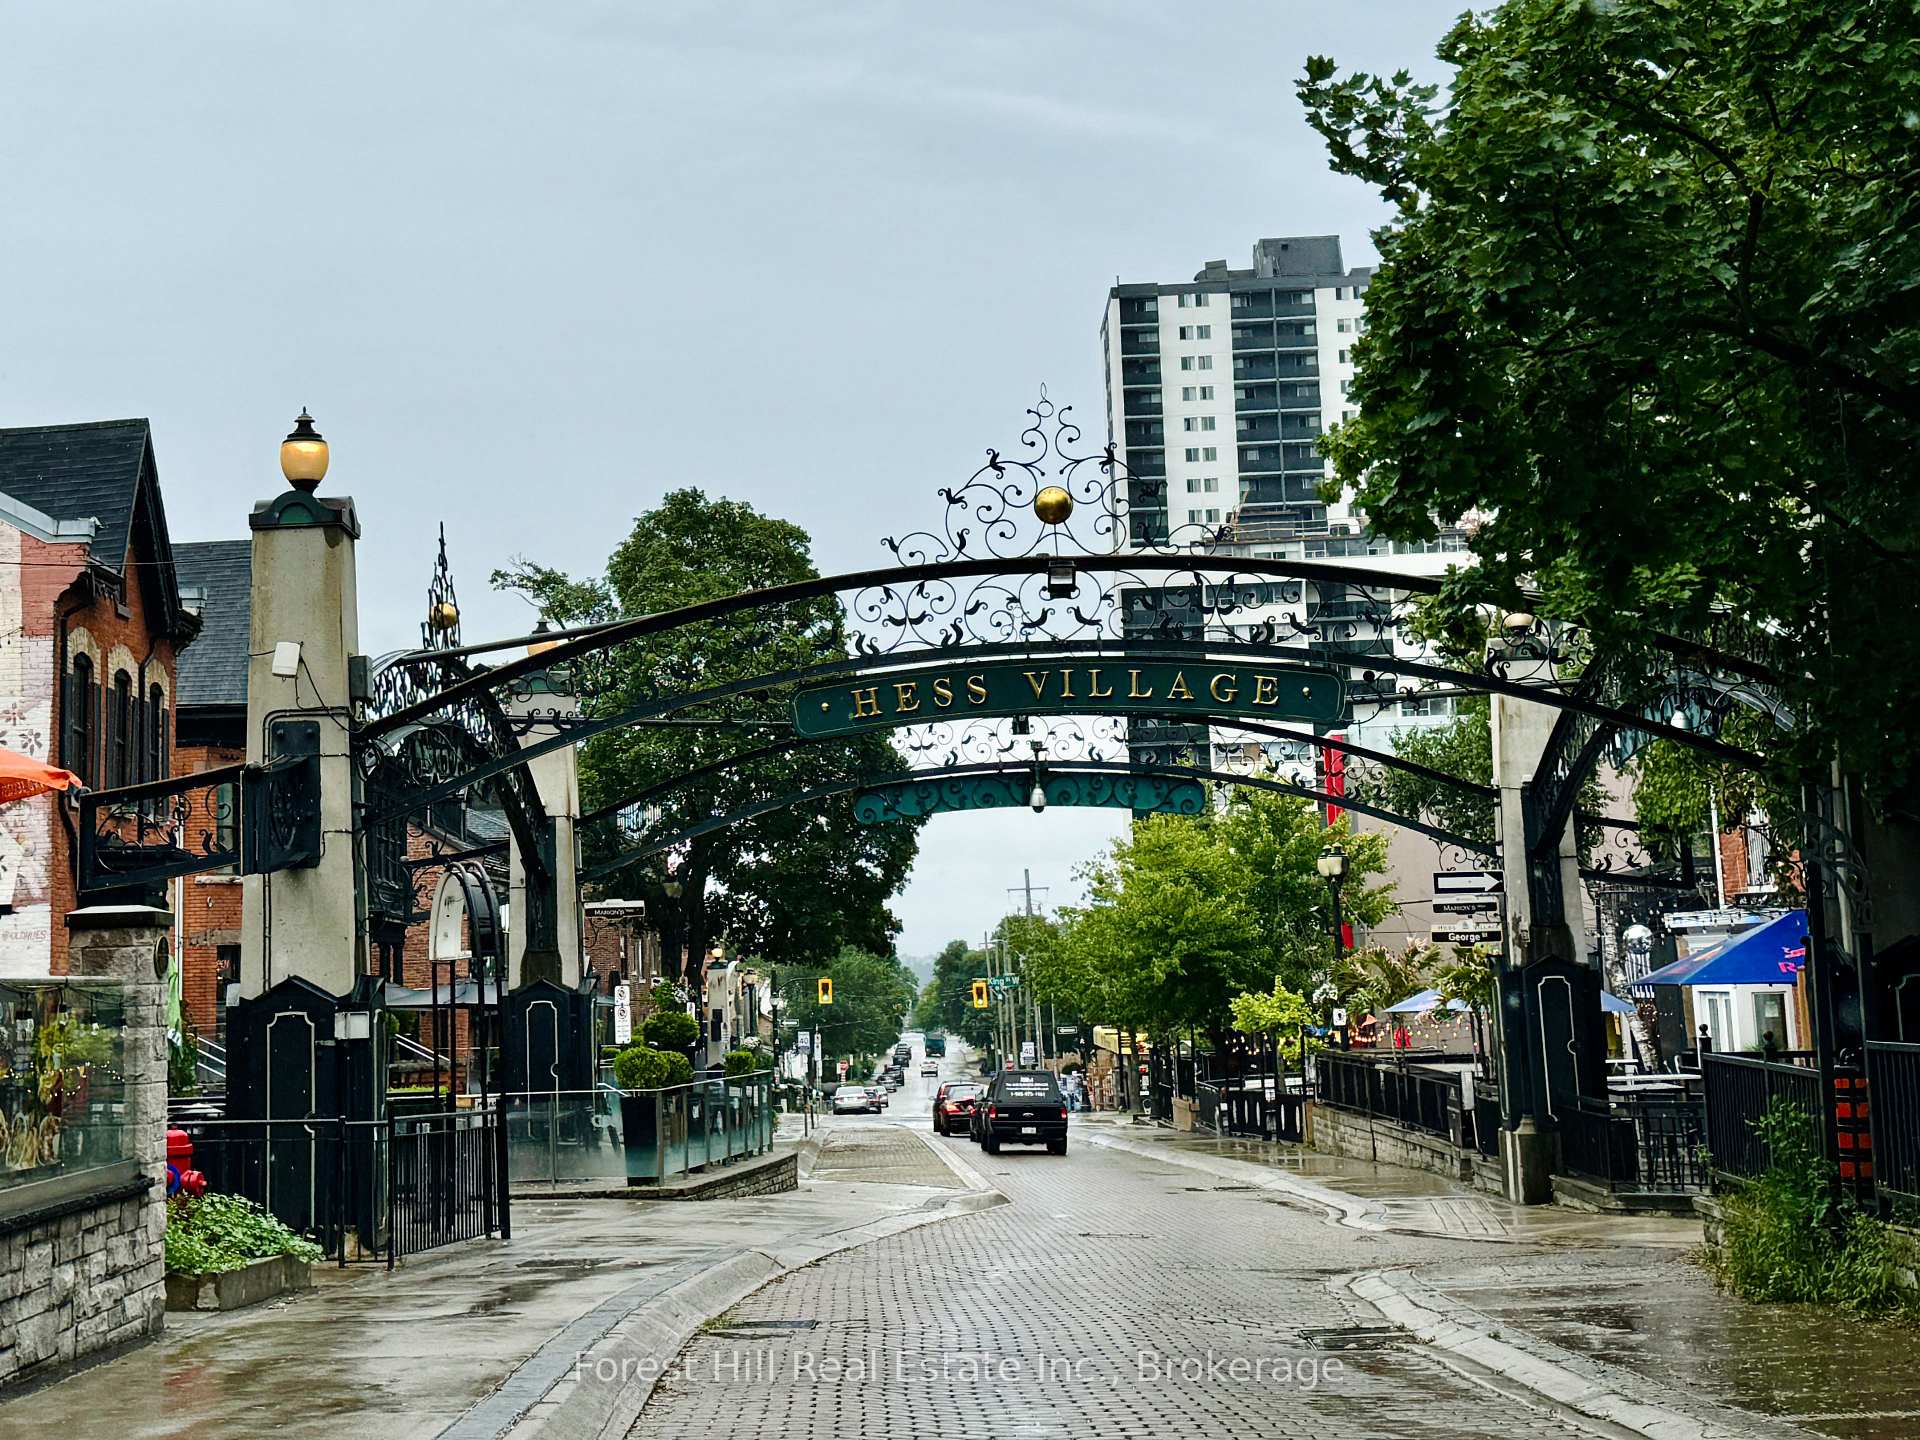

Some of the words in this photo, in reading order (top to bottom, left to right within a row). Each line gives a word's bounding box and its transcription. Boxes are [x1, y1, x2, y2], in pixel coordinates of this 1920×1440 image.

[850, 674, 987, 718] HESS
[1023, 669, 1279, 705] VILLAGE
[1448, 932, 1481, 943] George
[988, 977, 1005, 989] King
[1011, 975, 1020, 985] W
[800, 1036, 809, 1045] 40
[1024, 1047, 1034, 1055] 40
